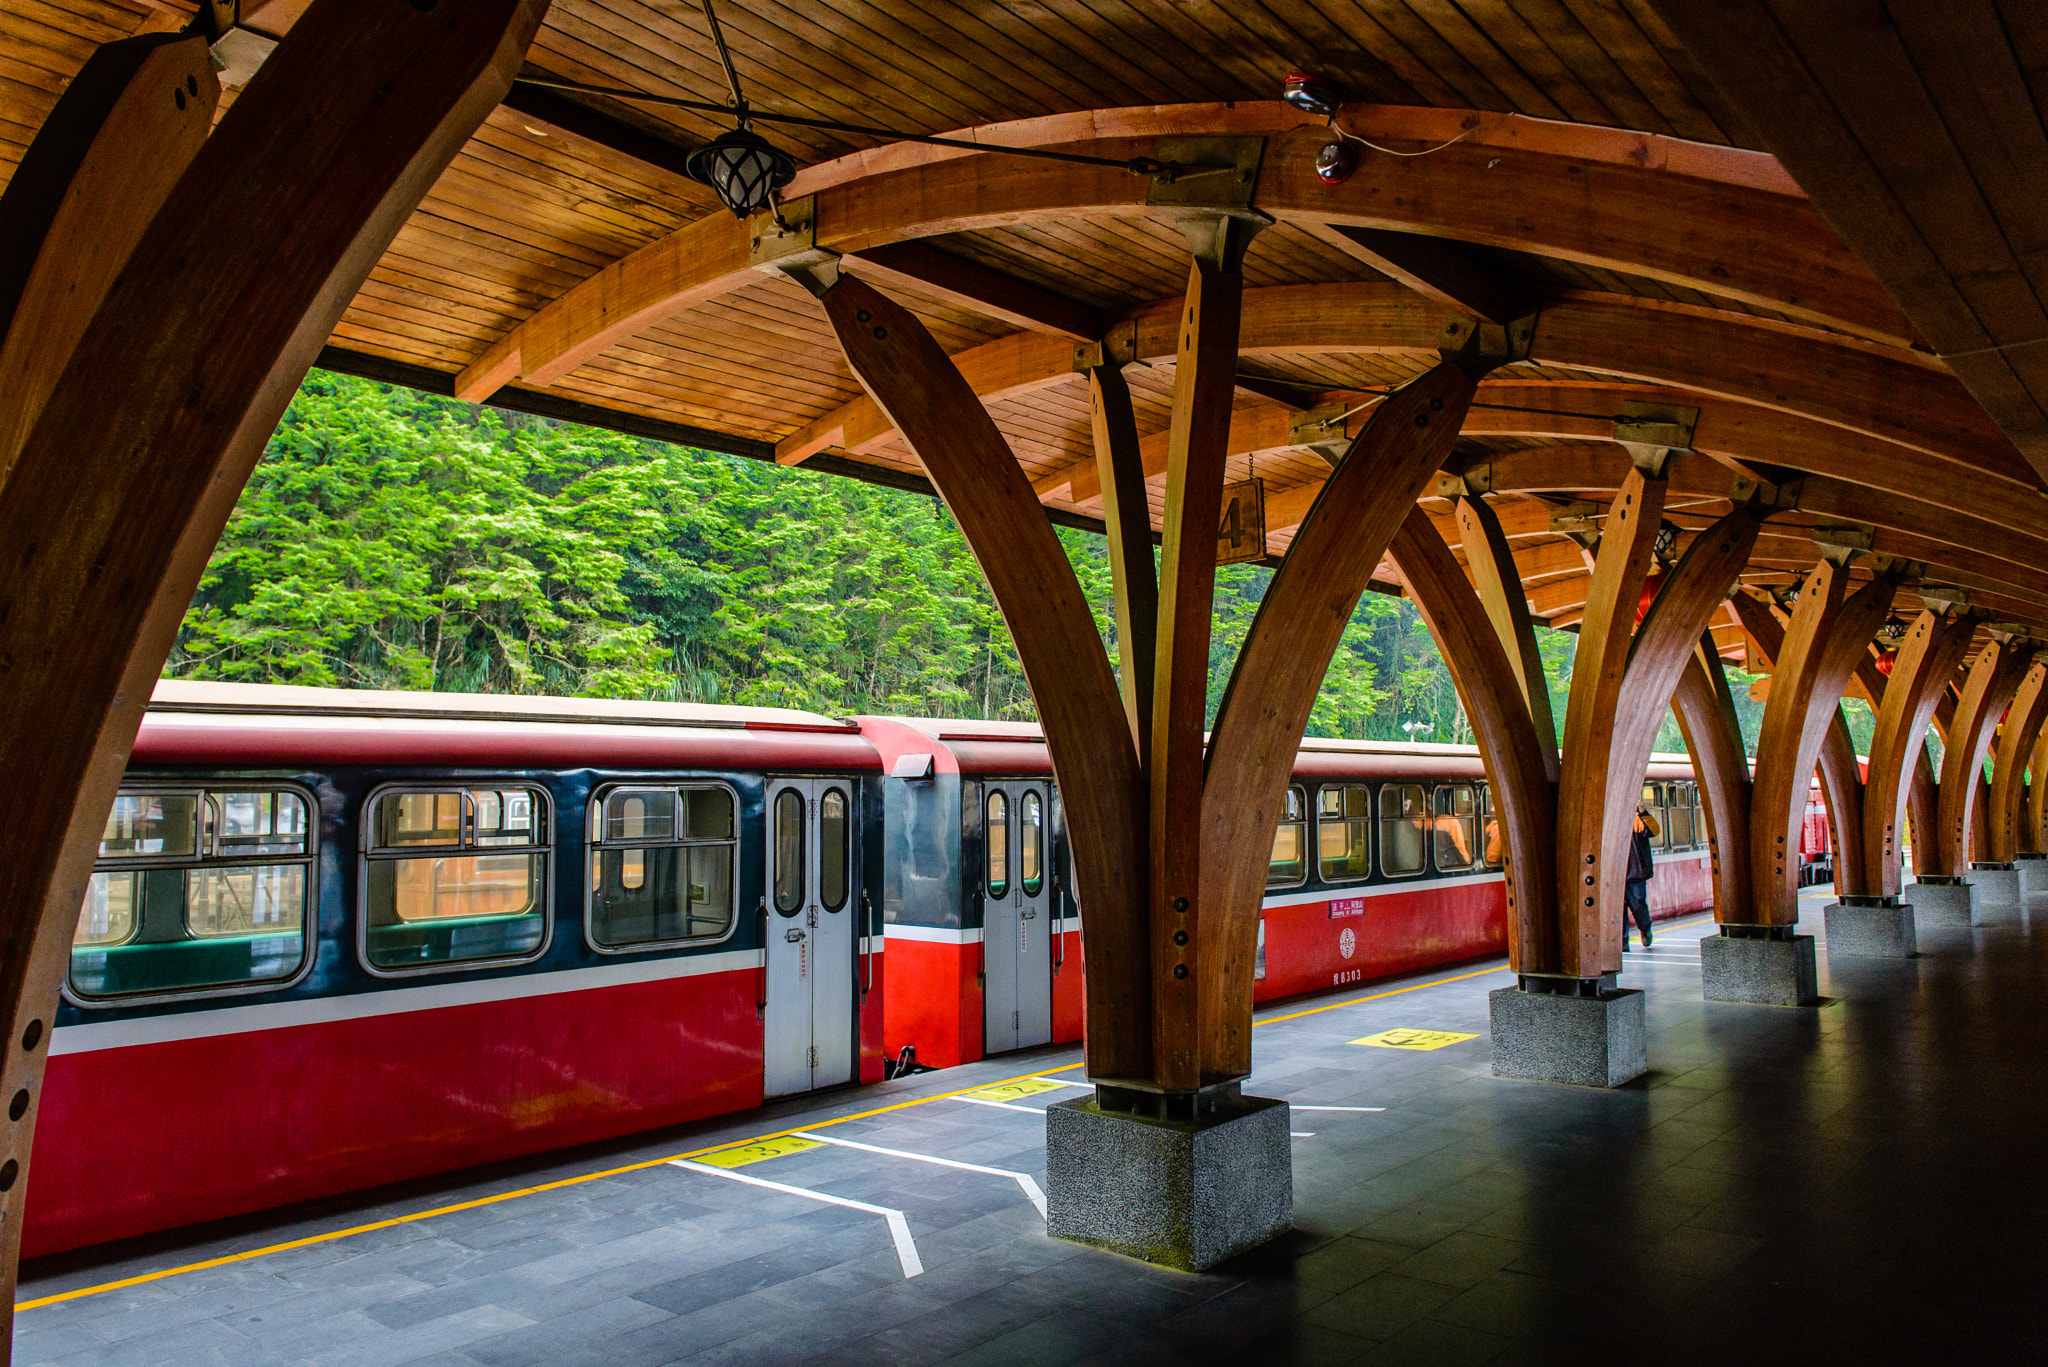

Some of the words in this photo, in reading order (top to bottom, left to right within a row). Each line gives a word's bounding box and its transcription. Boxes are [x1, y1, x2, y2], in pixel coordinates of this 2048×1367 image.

[1218, 497, 1246, 548] 4
[1002, 1086, 1037, 1094] 2
[744, 1146, 781, 1156] 3
